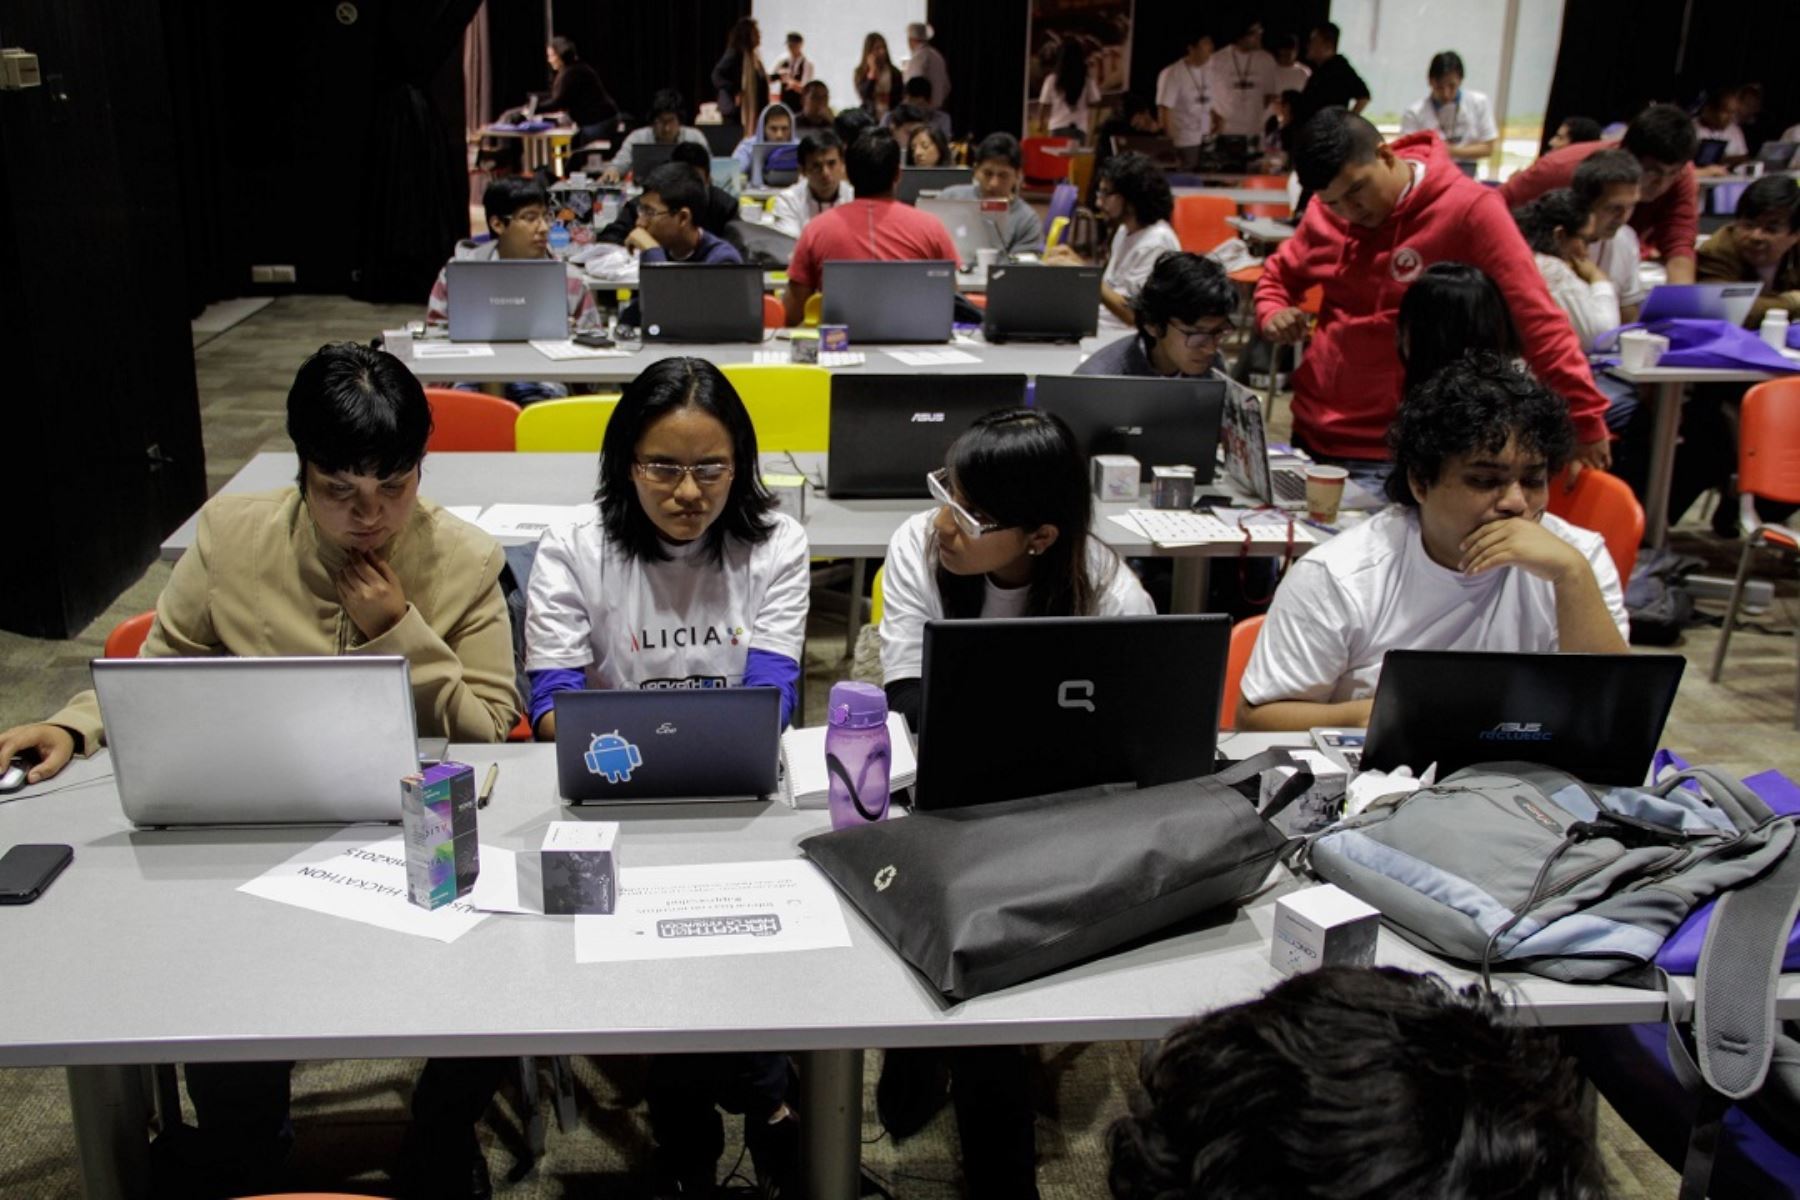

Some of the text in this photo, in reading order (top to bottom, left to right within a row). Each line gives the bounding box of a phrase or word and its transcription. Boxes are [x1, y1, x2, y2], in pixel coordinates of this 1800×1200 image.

[911, 412, 945, 422] ASUS
[1493, 722, 1543, 732] ASUS
[297, 866, 402, 897] HACKATHON
